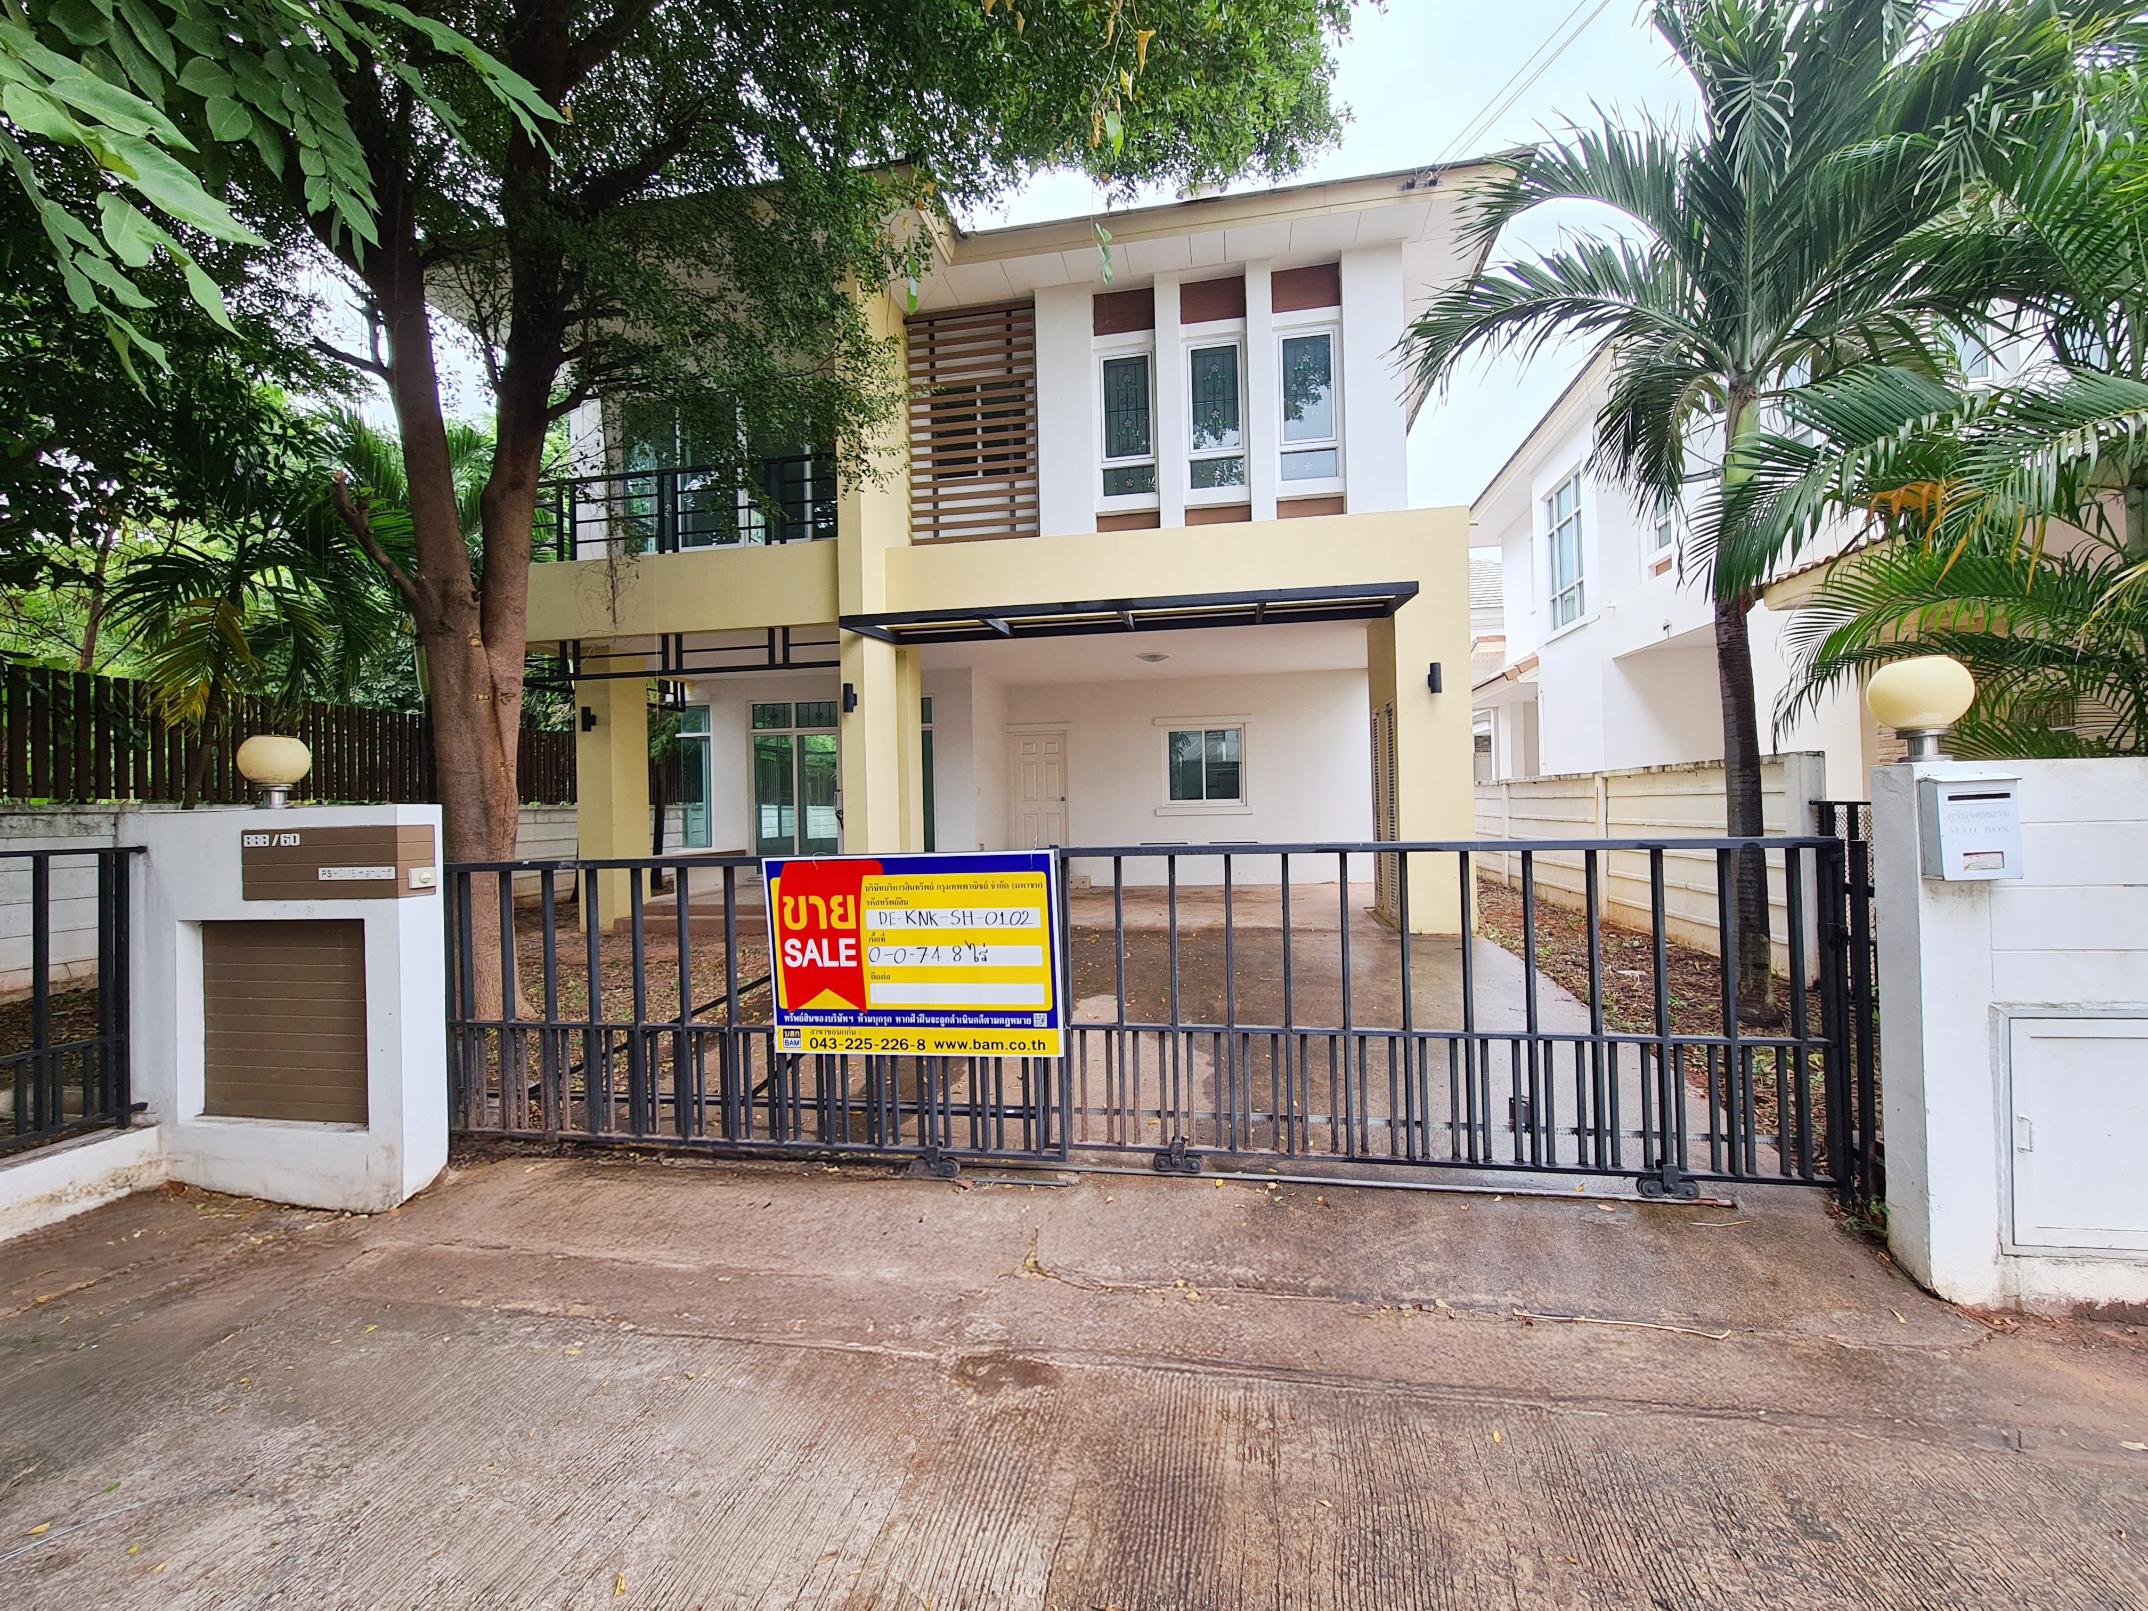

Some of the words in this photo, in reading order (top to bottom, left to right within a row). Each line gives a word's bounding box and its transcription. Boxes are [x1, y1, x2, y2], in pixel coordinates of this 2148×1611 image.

[782, 894, 857, 931] ขาย
[784, 938, 858, 968] SALE
[858, 1013, 892, 1026] ห้ามบุกรุก
[809, 1037, 926, 1050] 043-225-226-8
[934, 1039, 1046, 1051] www.bam.co.th
